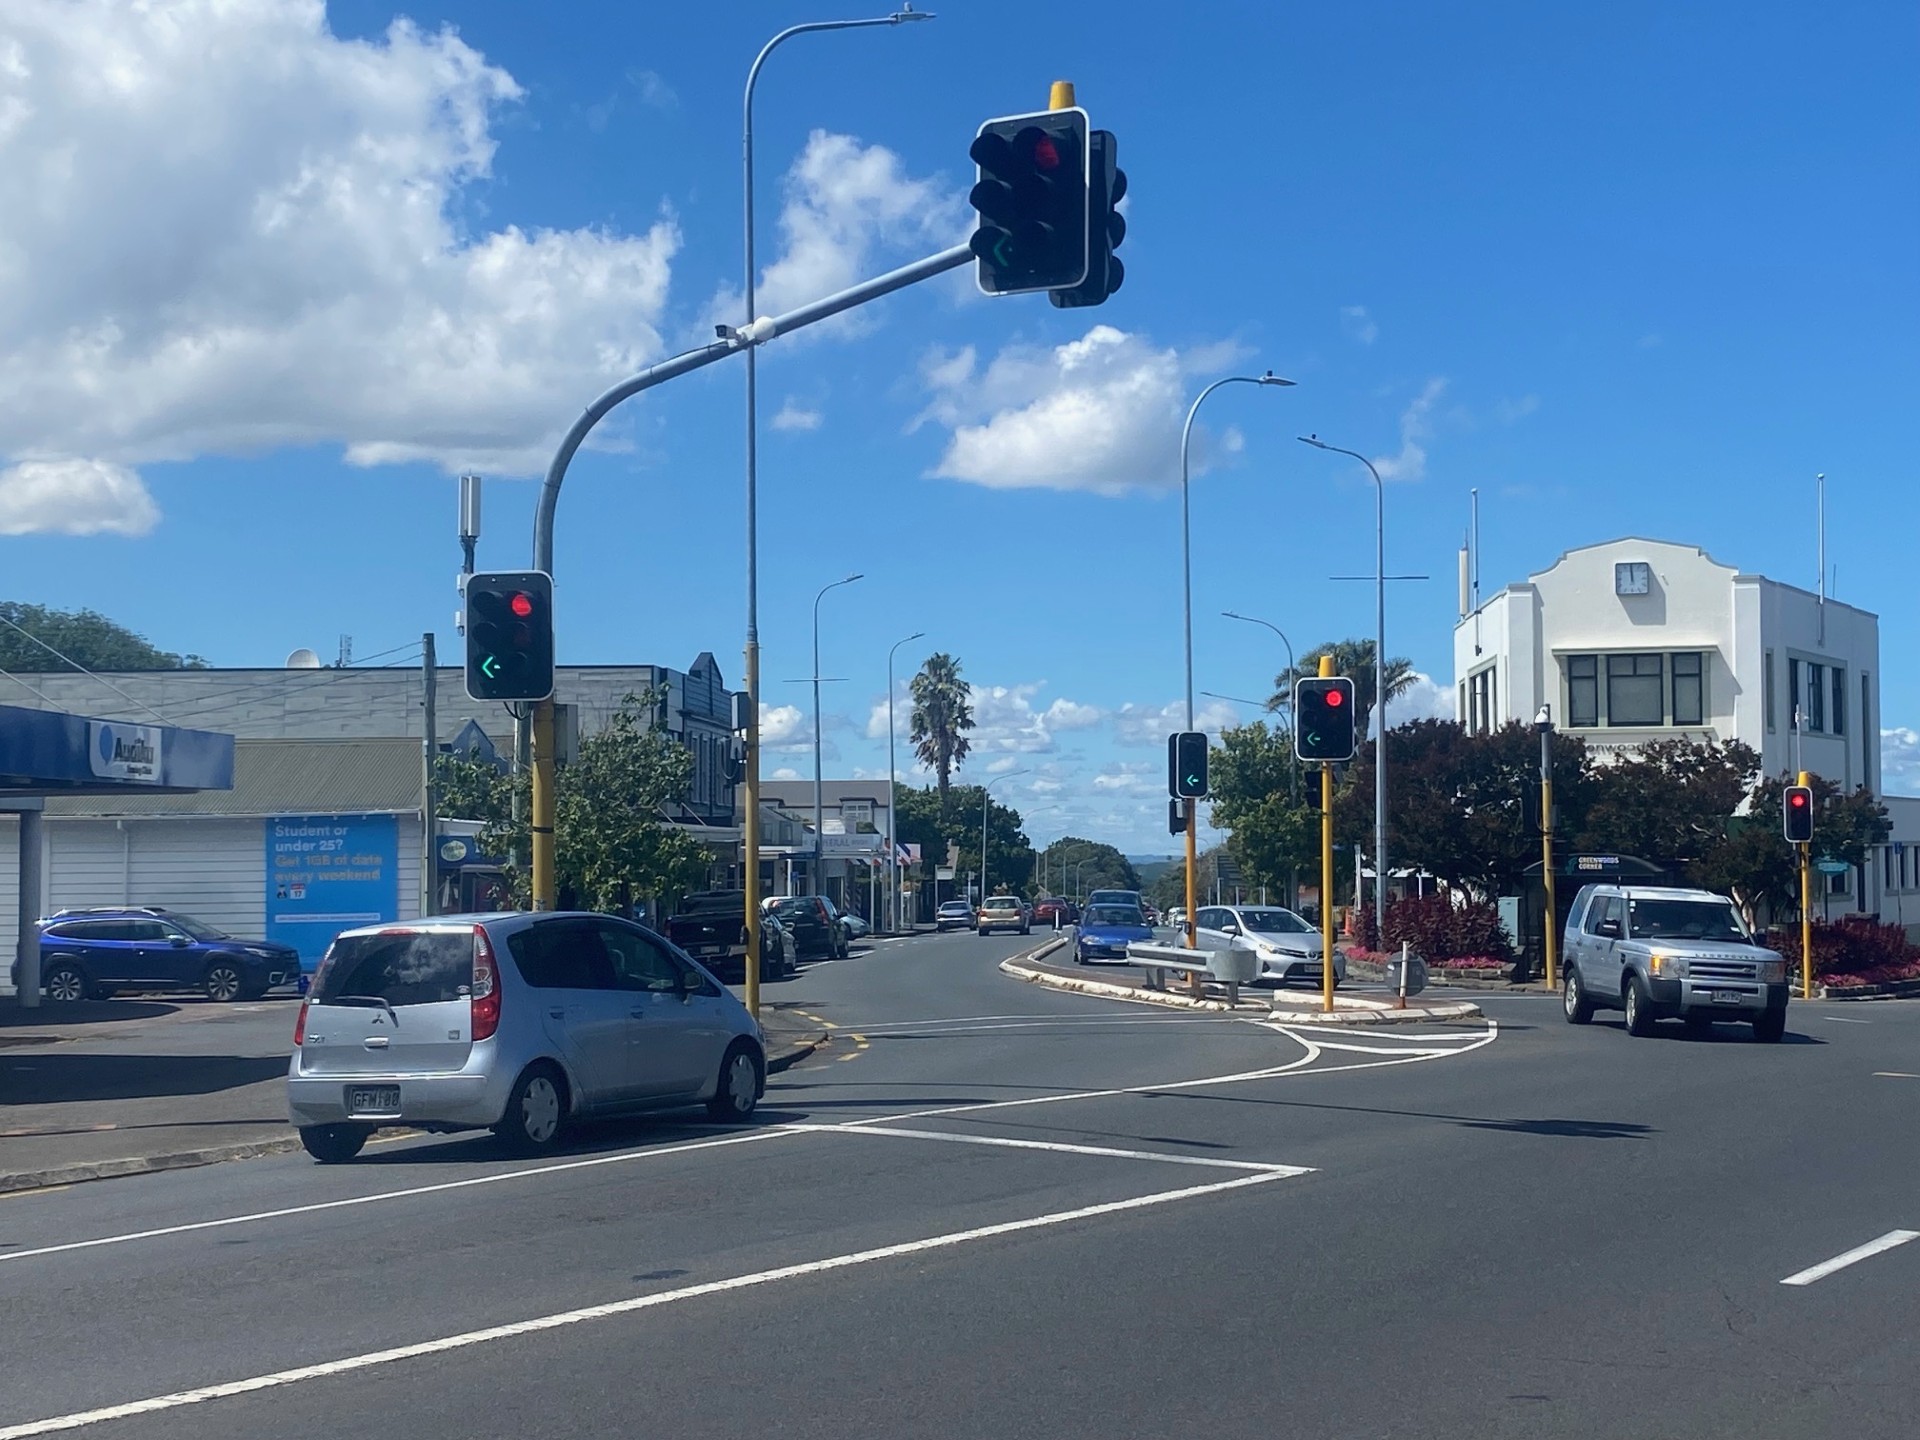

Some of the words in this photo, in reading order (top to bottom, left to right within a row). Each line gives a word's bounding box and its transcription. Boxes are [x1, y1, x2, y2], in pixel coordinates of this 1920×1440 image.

[275, 825, 331, 837] Student
[333, 827, 348, 836] or
[275, 841, 316, 852] under
[319, 839, 344, 851] 25?
